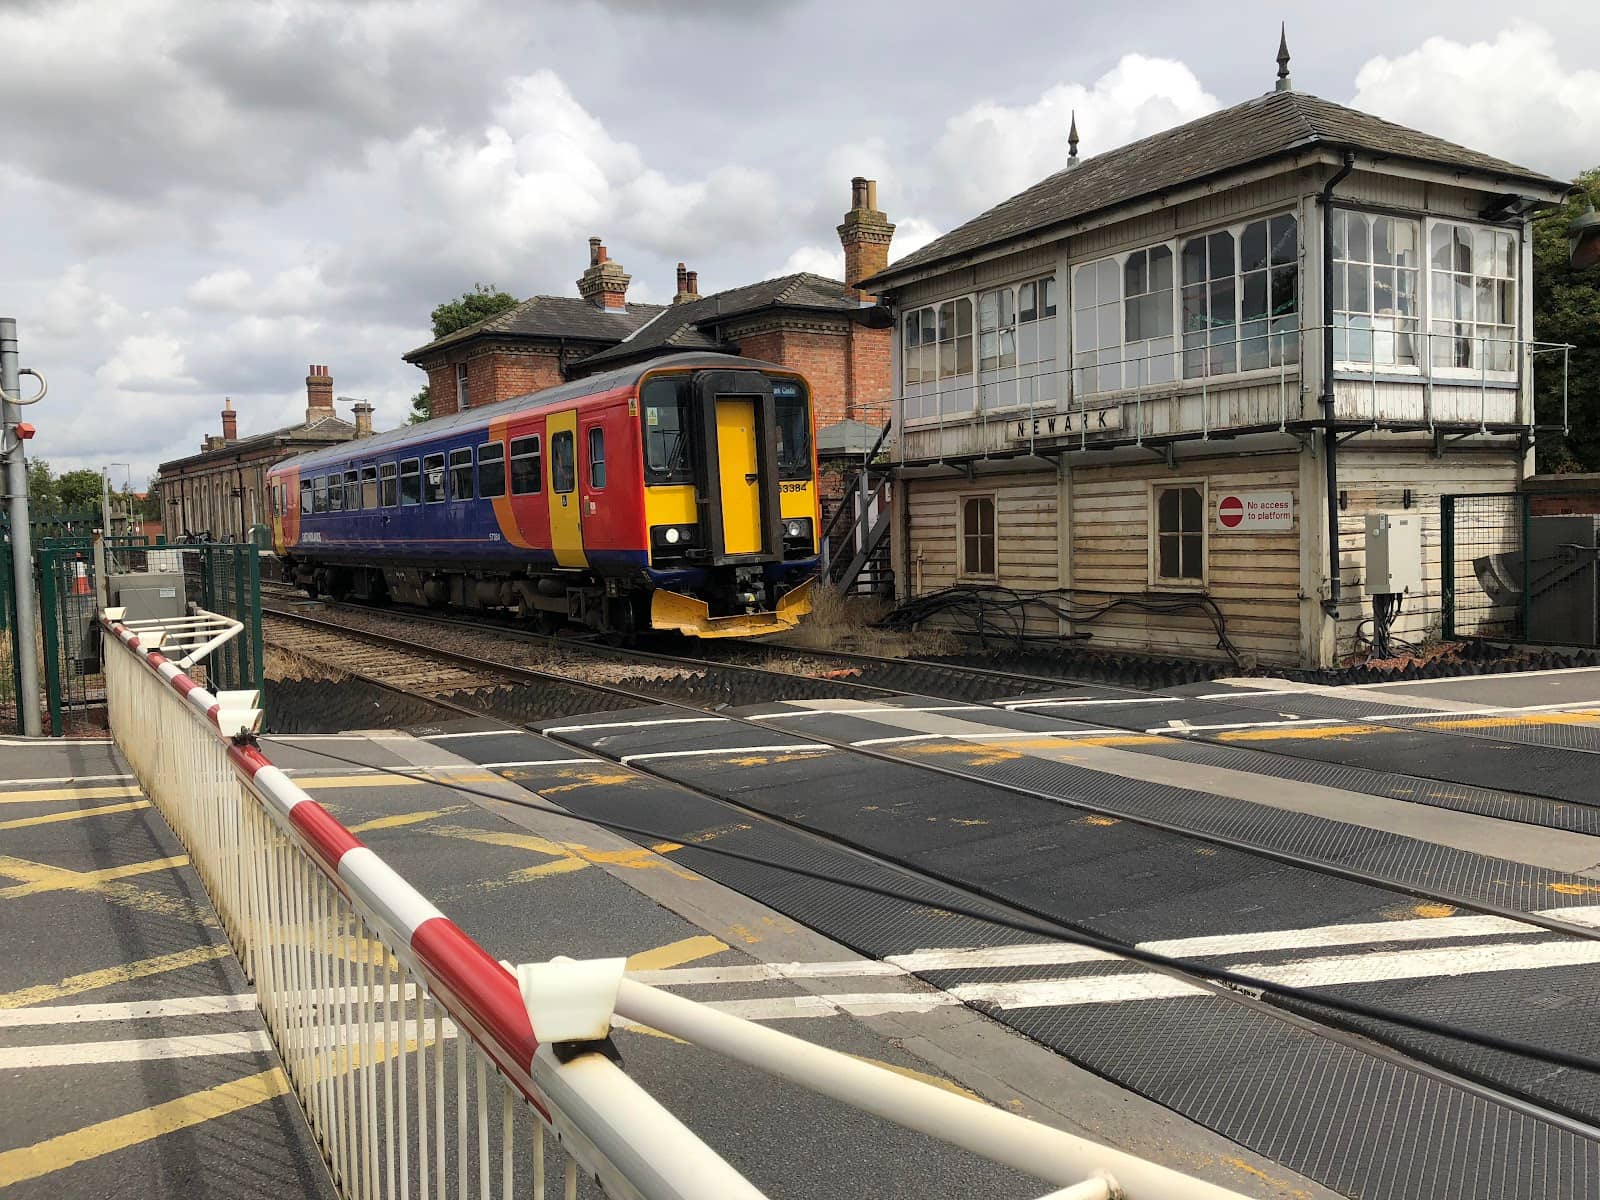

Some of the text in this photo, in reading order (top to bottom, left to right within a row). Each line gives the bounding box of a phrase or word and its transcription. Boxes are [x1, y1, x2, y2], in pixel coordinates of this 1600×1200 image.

[1017, 411, 1107, 437] NEWARK
[1247, 501, 1289, 510] No access
[1248, 511, 1291, 520] to platform
